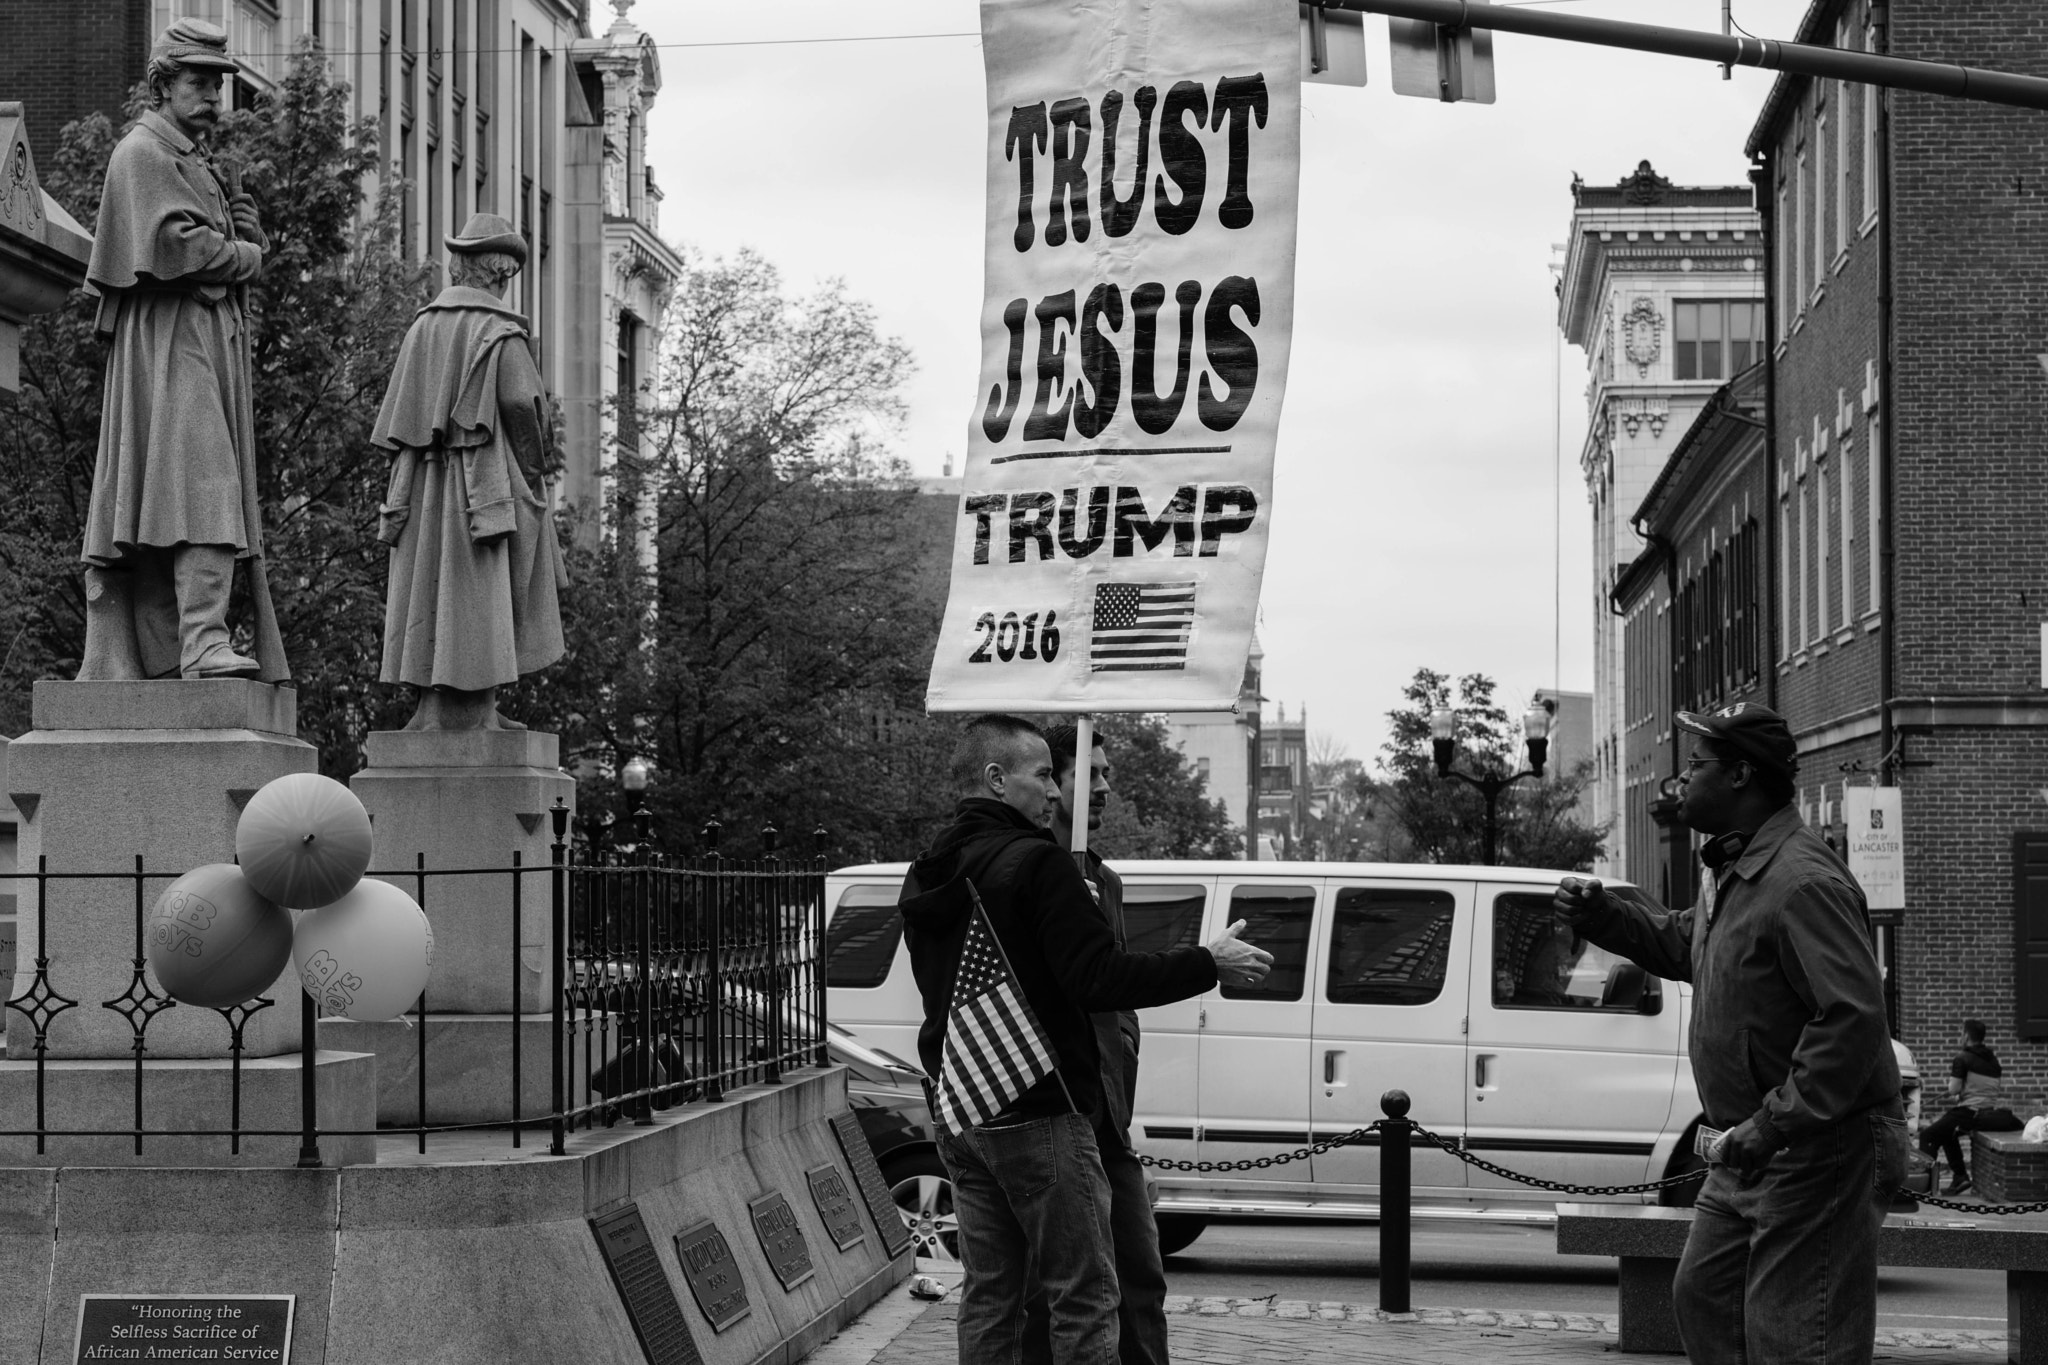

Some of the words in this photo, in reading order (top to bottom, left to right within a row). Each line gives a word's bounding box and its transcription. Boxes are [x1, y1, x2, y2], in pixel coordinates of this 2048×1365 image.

[1005, 71, 1269, 253] TRUST
[982, 275, 1261, 444] JESUS
[964, 484, 1258, 565] TRUMP
[968, 610, 1061, 664] 2016
[1866, 833, 1879, 841] CITY
[1880, 833, 1888, 841] OF
[1853, 843, 1899, 853] LANCASTER
[217, 1305, 242, 1319] the
[110, 1325, 168, 1339] Selfless
[172, 1325, 237, 1339] Sacrifice
[241, 1324, 260, 1339] of
[84, 1344, 140, 1359] African
[144, 1345, 218, 1359] American
[223, 1345, 279, 1360] Service
